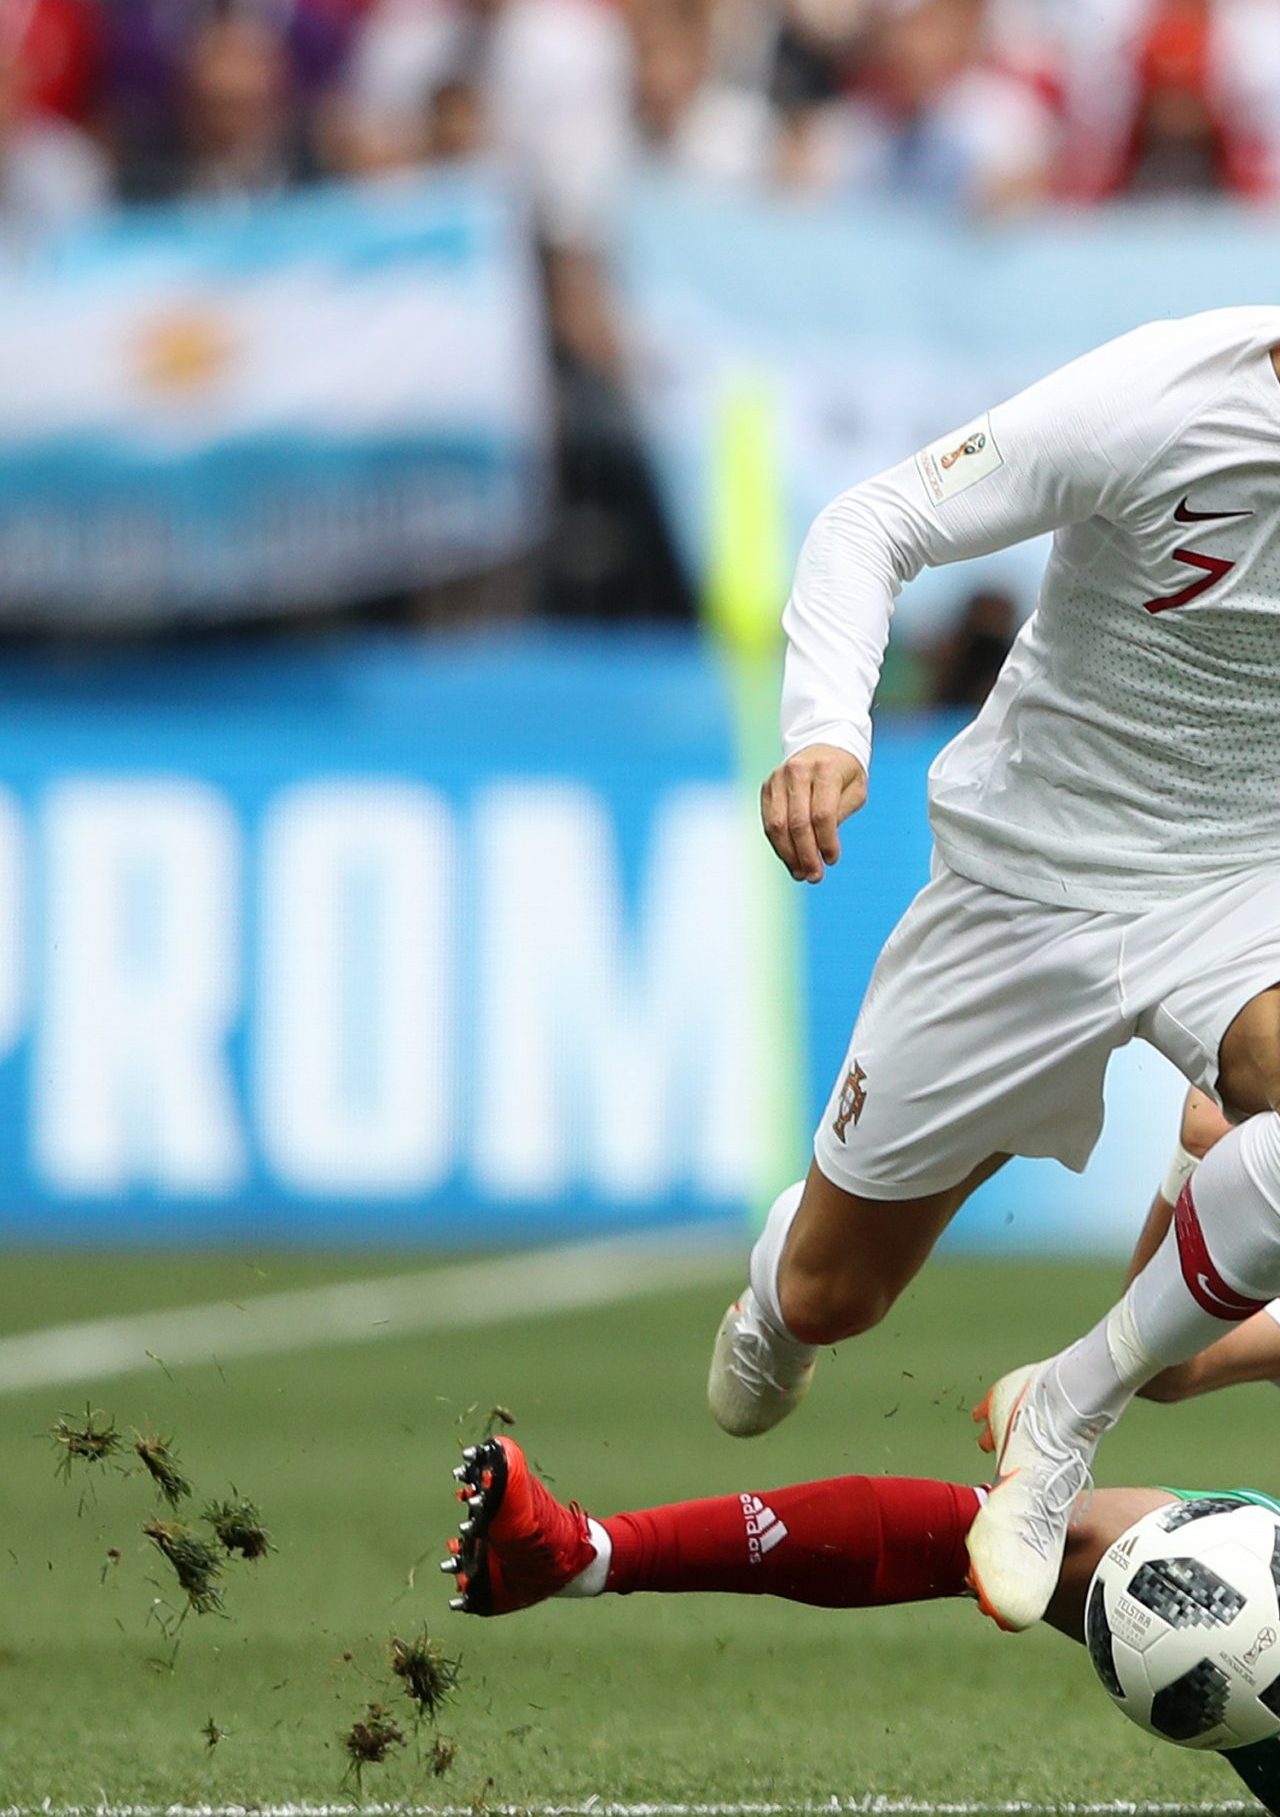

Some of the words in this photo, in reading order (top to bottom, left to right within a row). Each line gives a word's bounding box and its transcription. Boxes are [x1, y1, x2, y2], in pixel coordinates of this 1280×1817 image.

[1142, 547, 1237, 615] 7
[0, 772, 756, 1200] ROM
[740, 1493, 762, 1564] adidas
